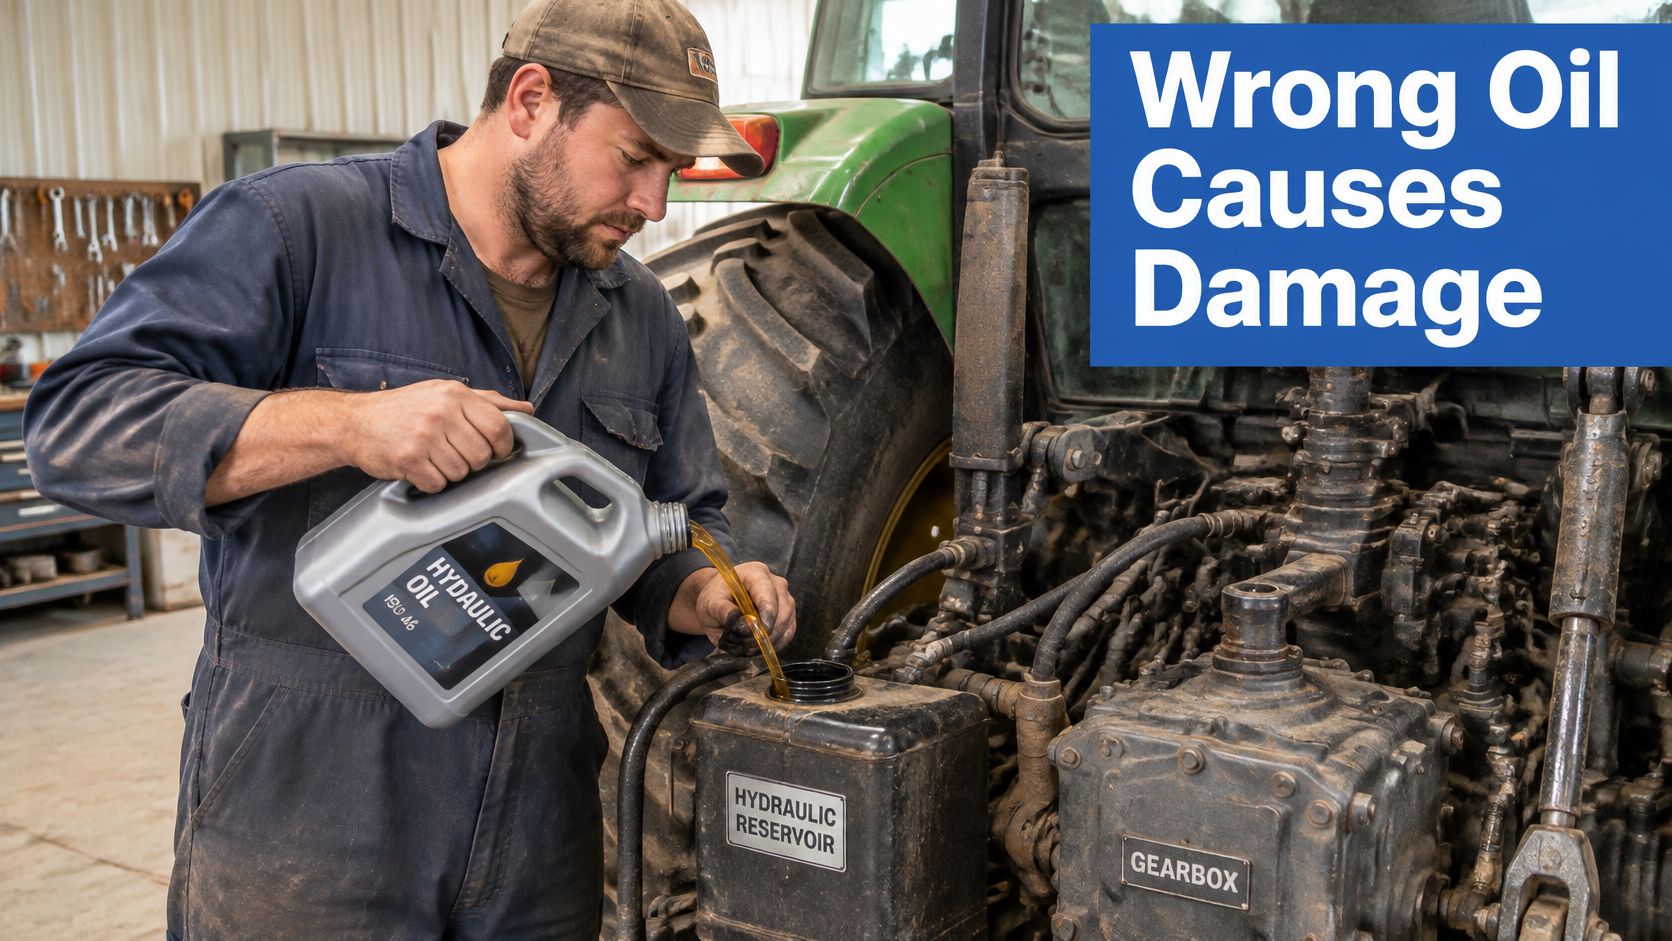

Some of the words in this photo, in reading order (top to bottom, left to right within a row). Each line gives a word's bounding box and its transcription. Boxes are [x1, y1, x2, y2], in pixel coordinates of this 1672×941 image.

[406, 574, 440, 608] OIL
[426, 557, 511, 641] HYDAULIC
[735, 787, 836, 827] HYDRAULIC
[736, 813, 835, 854] RESERVOIR
[1130, 851, 1239, 894] GEARBOX
